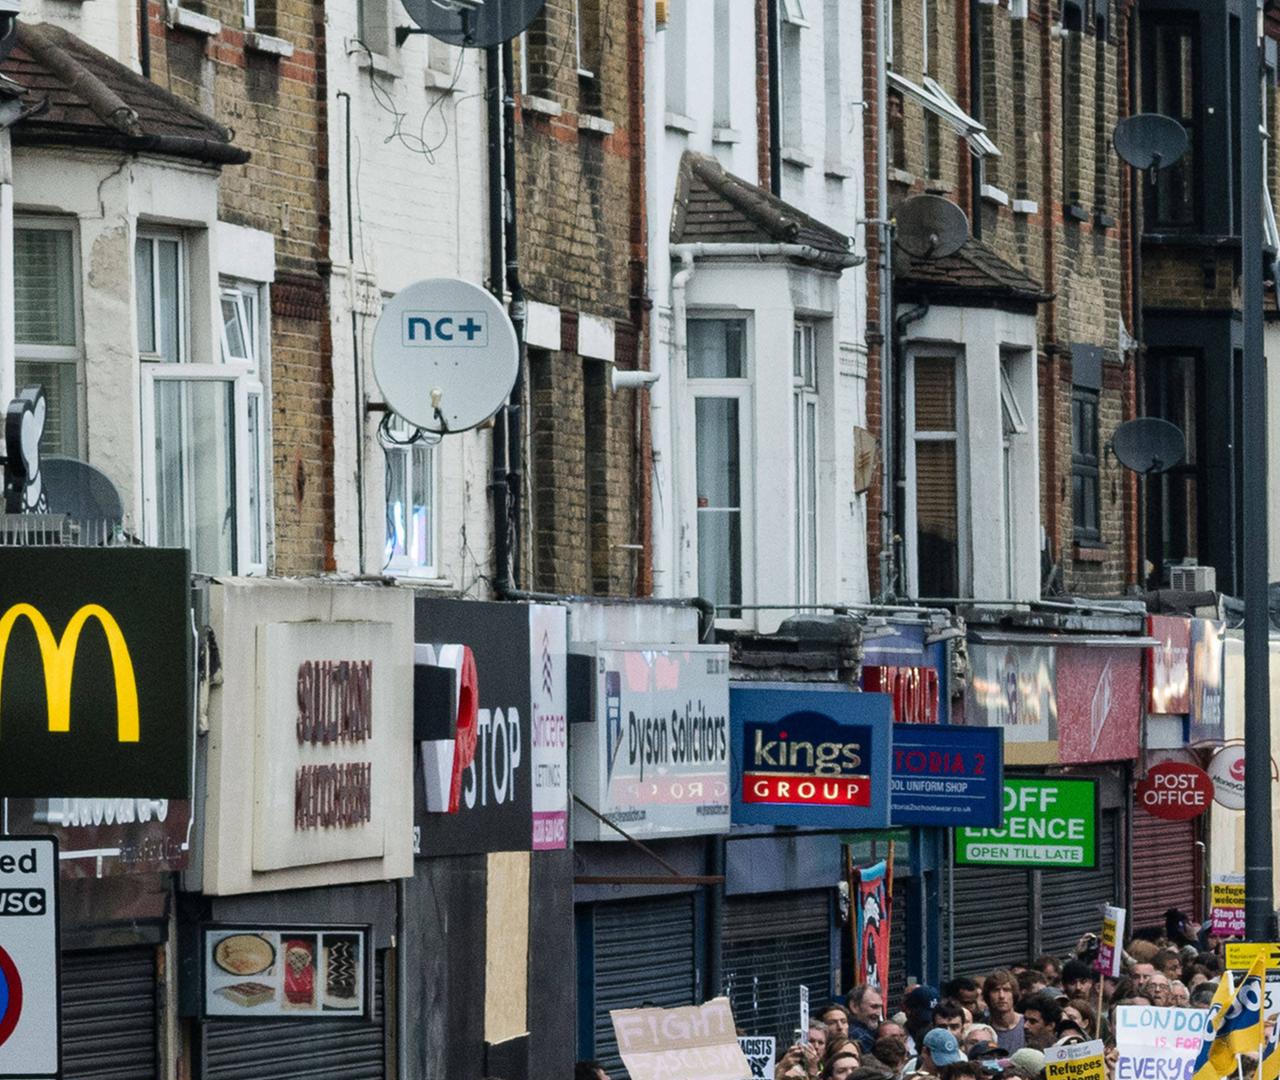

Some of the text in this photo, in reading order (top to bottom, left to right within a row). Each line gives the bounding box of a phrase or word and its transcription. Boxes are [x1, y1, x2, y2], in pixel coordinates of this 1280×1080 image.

[408, 318, 481, 340] nc+
[629, 700, 726, 783] Dyson Solicitors
[464, 707, 521, 809] STOP
[754, 729, 861, 777] kings
[974, 754, 985, 775] 2
[754, 781, 859, 800] GROUP
[906, 781, 944, 792] UNIFORM
[946, 782, 968, 793] SHOP
[1154, 775, 1199, 789] POST
[1003, 788, 1058, 812] OFF
[1144, 791, 1204, 806] OFFICE
[965, 818, 1085, 839] LICENCE
[971, 847, 1079, 860] OPEN TILL LATE
[614, 1004, 727, 1049] FIGHT
[1175, 1036, 1201, 1050] FOR
